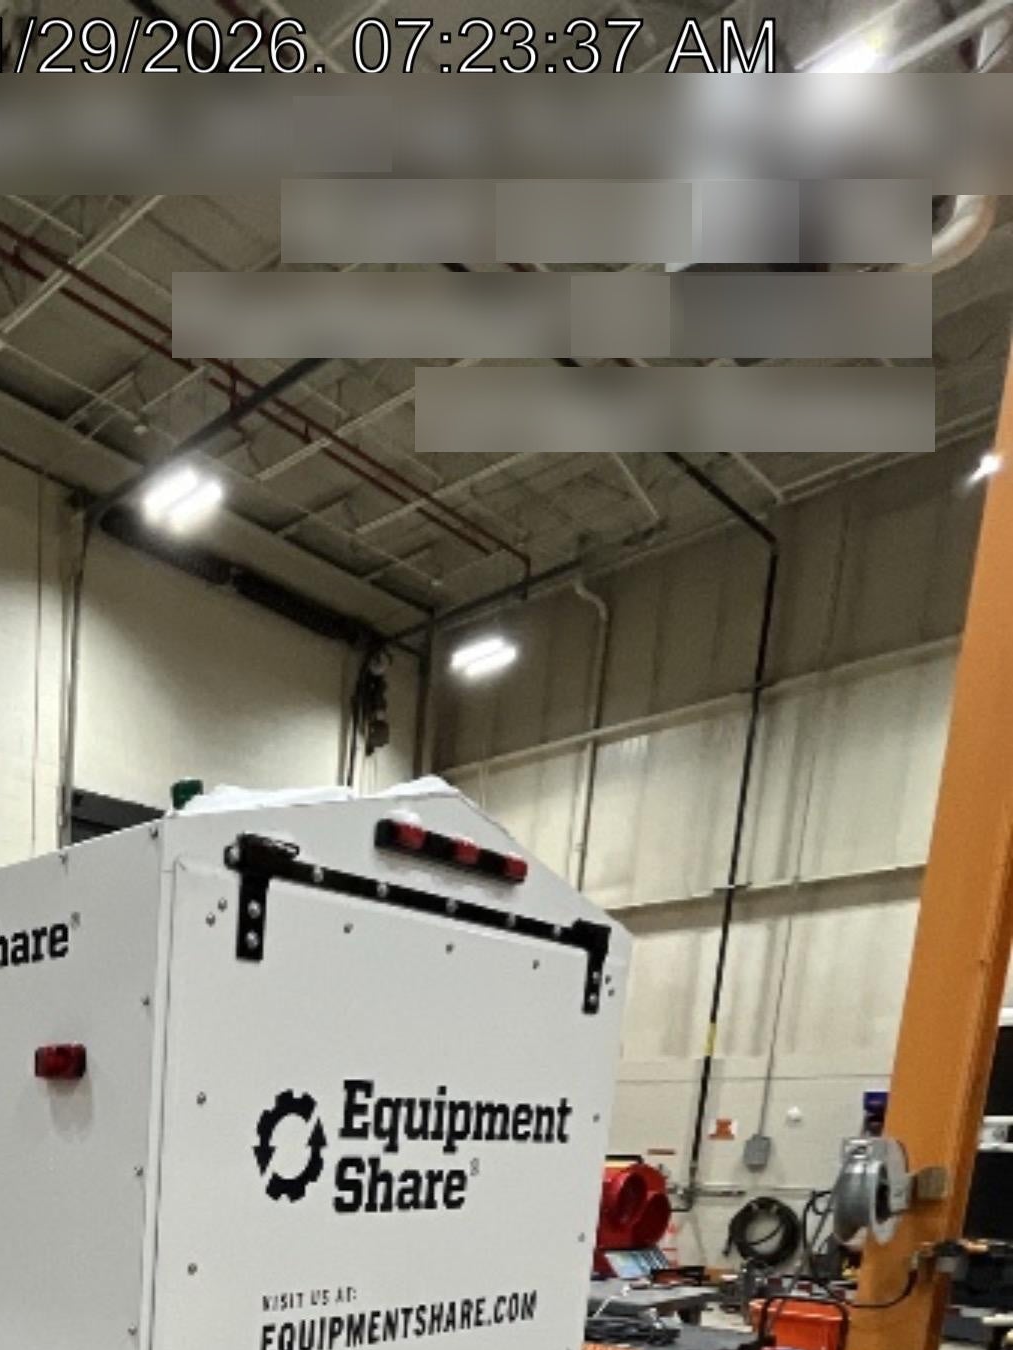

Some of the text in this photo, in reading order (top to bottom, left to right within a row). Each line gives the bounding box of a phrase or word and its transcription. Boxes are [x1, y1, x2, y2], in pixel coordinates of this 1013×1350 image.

[338, 1079, 572, 1153] Equipment
[333, 1156, 467, 1213] Share
[261, 1291, 303, 1312] VISIT
[310, 1289, 330, 1306] US
